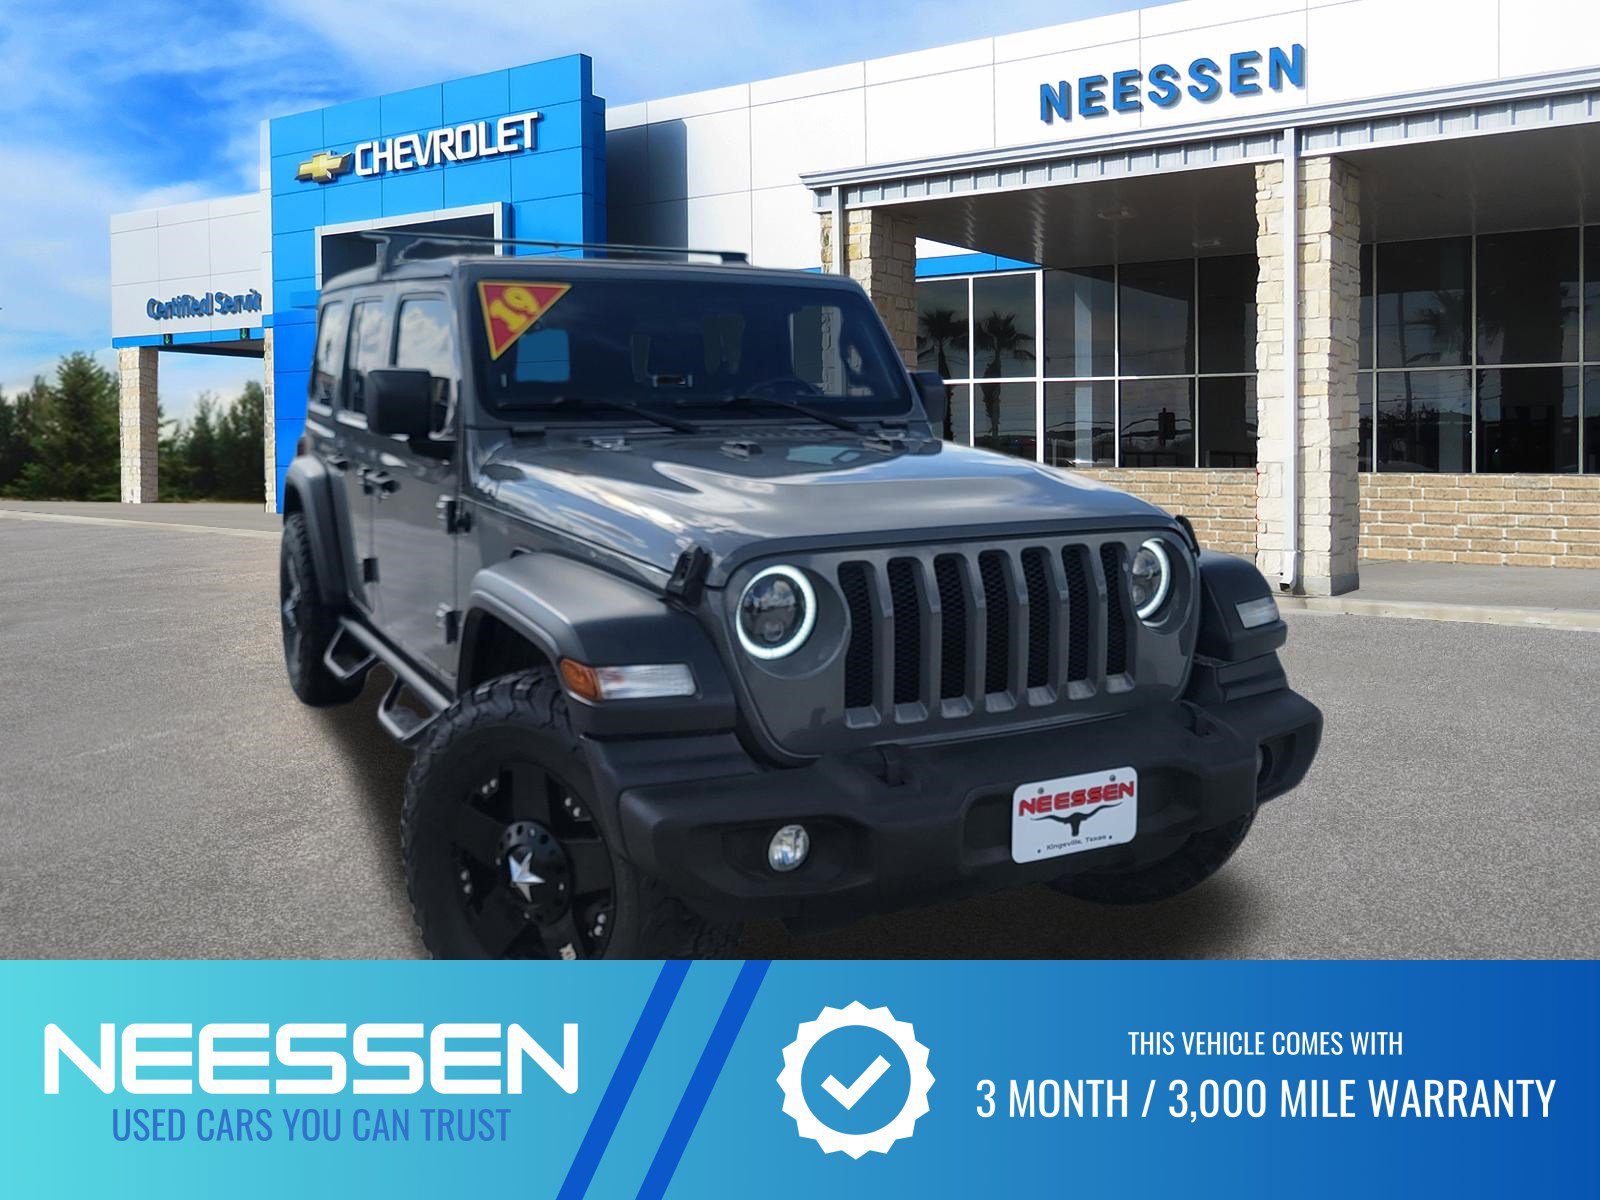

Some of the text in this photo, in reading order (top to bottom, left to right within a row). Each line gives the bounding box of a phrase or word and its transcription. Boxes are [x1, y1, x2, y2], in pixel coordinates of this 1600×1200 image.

[1039, 43, 1306, 125] NEESSEN
[354, 111, 544, 177] CHEVROLET
[146, 292, 214, 320] Certified
[490, 286, 540, 333] 19
[1018, 780, 1135, 817] NEESSEN
